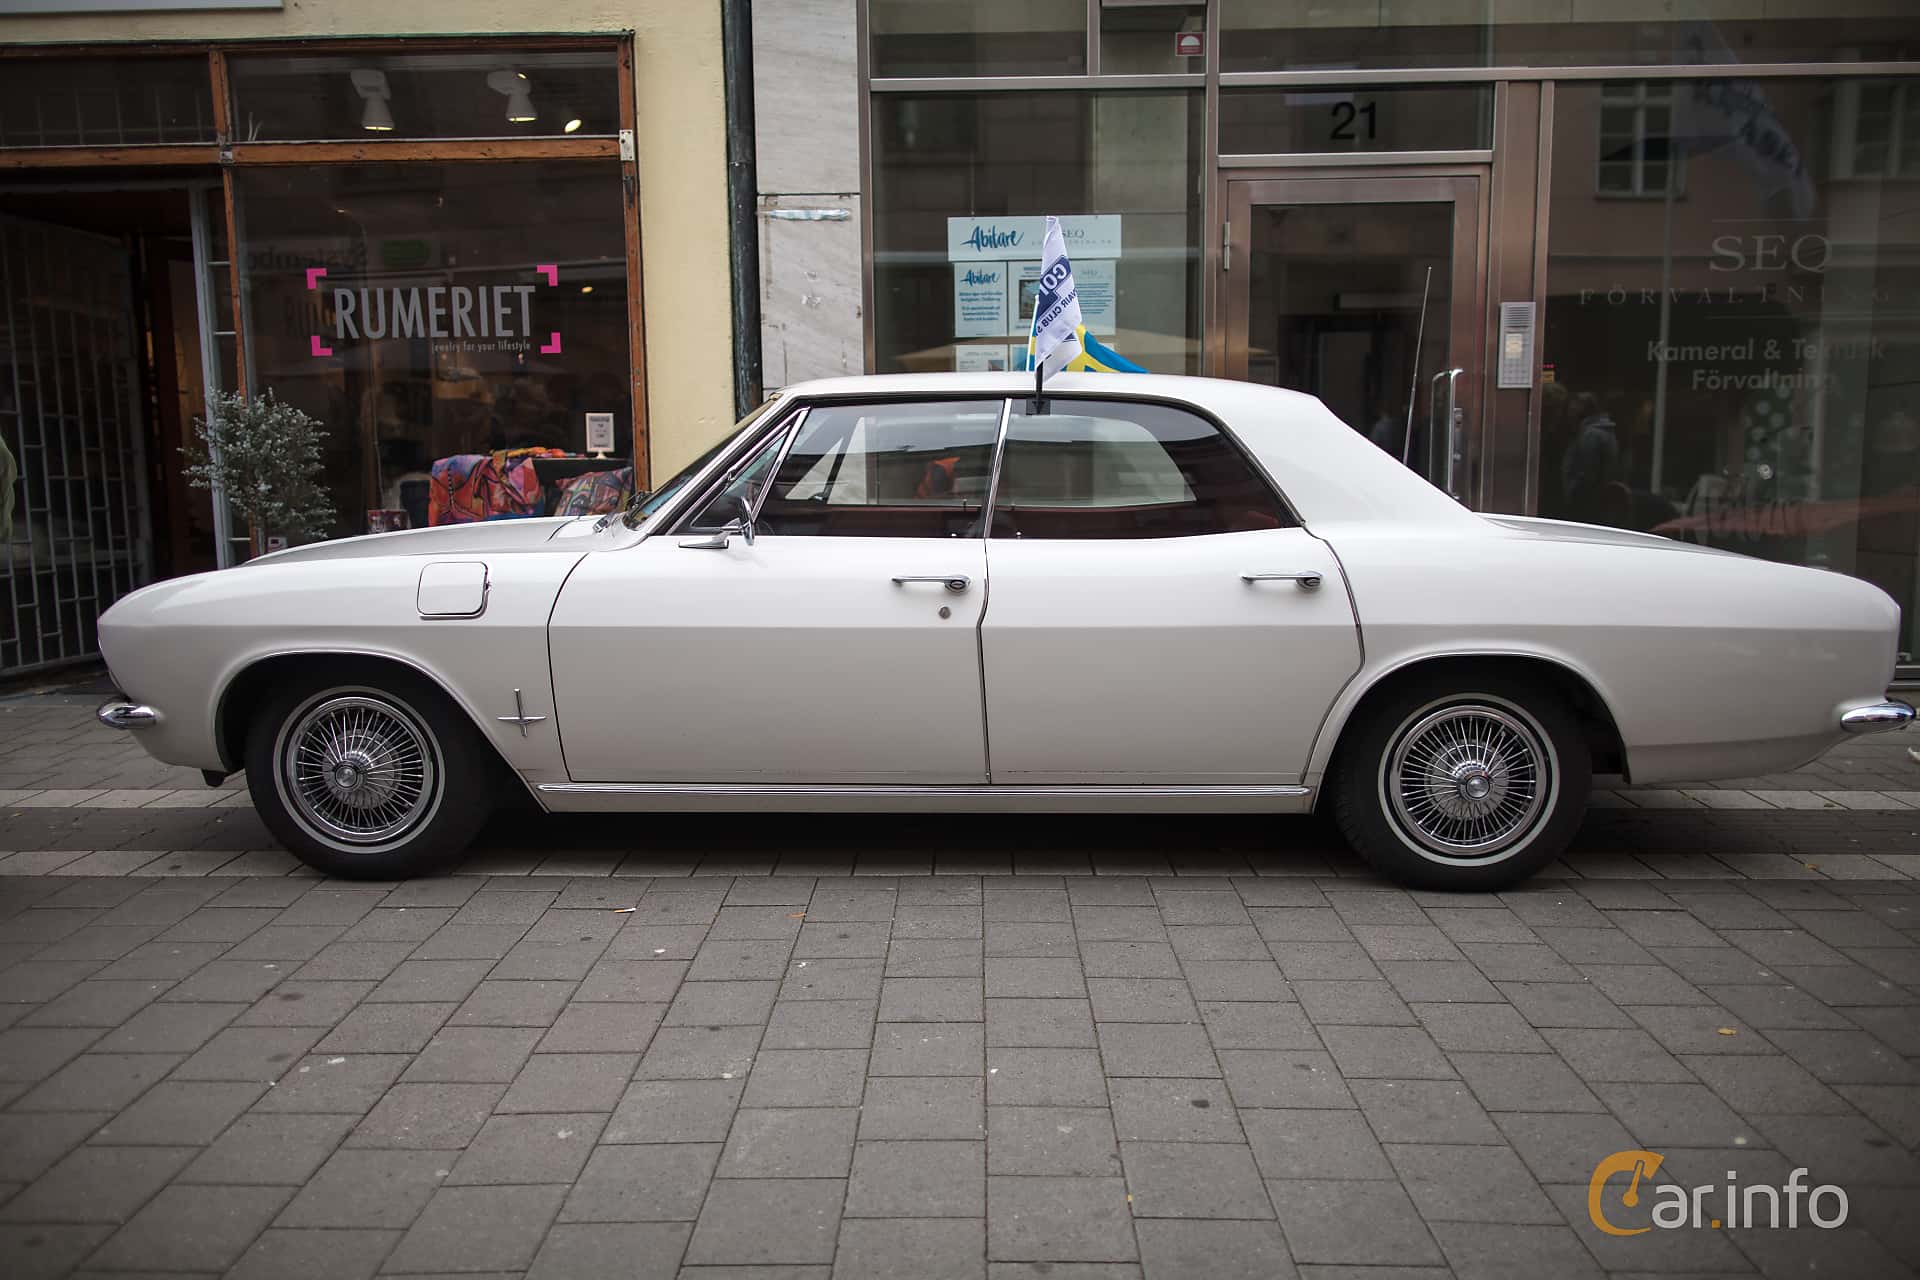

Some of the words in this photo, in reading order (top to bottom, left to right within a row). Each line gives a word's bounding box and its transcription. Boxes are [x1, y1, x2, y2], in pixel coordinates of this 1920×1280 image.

[1330, 101, 1376, 139] 21
[960, 225, 1024, 252] Abitare
[1709, 233, 1833, 273] SEQ
[334, 285, 536, 340] RUMERIET
[463, 340, 475, 351] for
[477, 343, 496, 353] your
[498, 339, 531, 352] lifestyle
[1647, 338, 1753, 361] Kameral
[1763, 339, 1781, 360] &
